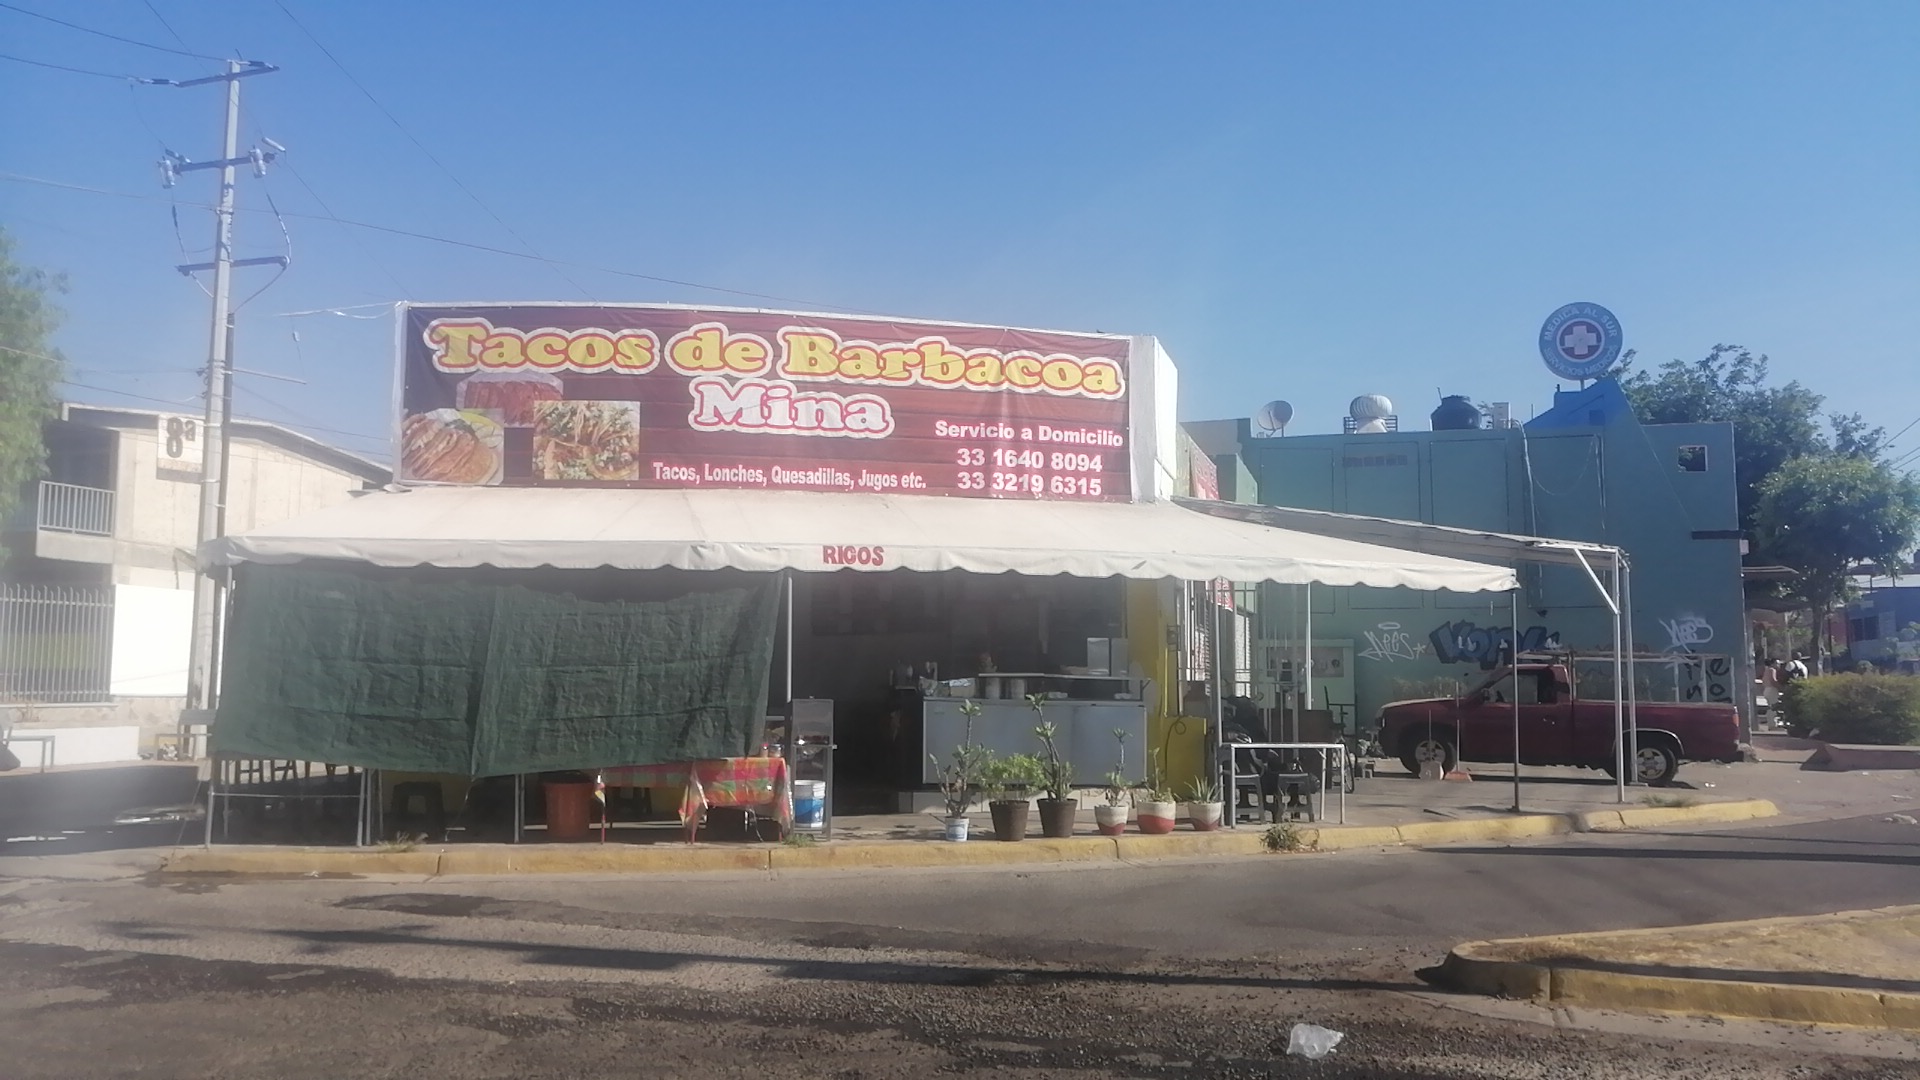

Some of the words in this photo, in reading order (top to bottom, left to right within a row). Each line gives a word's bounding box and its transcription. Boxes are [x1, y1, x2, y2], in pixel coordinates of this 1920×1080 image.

[1544, 307, 1580, 341] MEDICA
[1583, 307, 1599, 318] AL
[1601, 315, 1618, 338] SUR
[426, 319, 658, 372] Tacos
[667, 324, 771, 374] de
[779, 328, 1123, 397] Barbacoa
[691, 378, 893, 436] Mina
[935, 420, 1015, 440] Servicio
[1021, 426, 1033, 440] a
[1039, 425, 1124, 447] Domicilio
[957, 448, 985, 466] 33
[993, 449, 1044, 469] 1640
[1051, 452, 1103, 472] 8094
[653, 462, 700, 484] Tacos,
[704, 463, 768, 487] Lonches,
[771, 465, 855, 489] Quesadillas,
[858, 469, 898, 491] Jugos
[901, 471, 927, 489] etc.
[957, 472, 985, 489] 33
[992, 472, 1044, 492] 3219
[1051, 476, 1102, 496] 6315
[822, 545, 884, 566] RICOS
